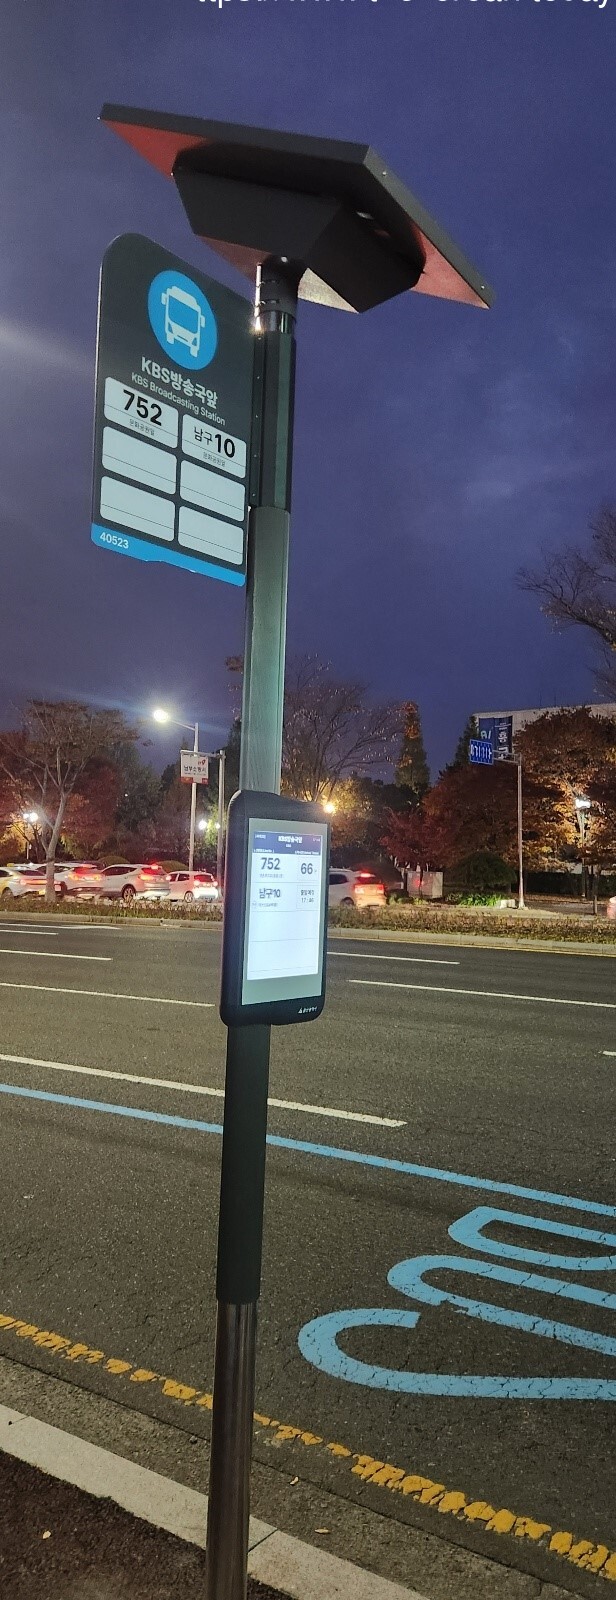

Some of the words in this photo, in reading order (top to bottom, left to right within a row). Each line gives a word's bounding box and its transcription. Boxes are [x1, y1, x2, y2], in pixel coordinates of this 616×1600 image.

[141, 356, 218, 409] KBS방송국앞
[123, 389, 162, 426] 752
[131, 372, 149, 388] KBS
[150, 381, 199, 415] Broadcasting
[200, 406, 226, 426] Station
[194, 426, 236, 458] 남구10
[99, 531, 129, 549] 40523
[261, 857, 281, 870] 752
[300, 862, 314, 875] 66
[259, 887, 281, 899] 남구10
